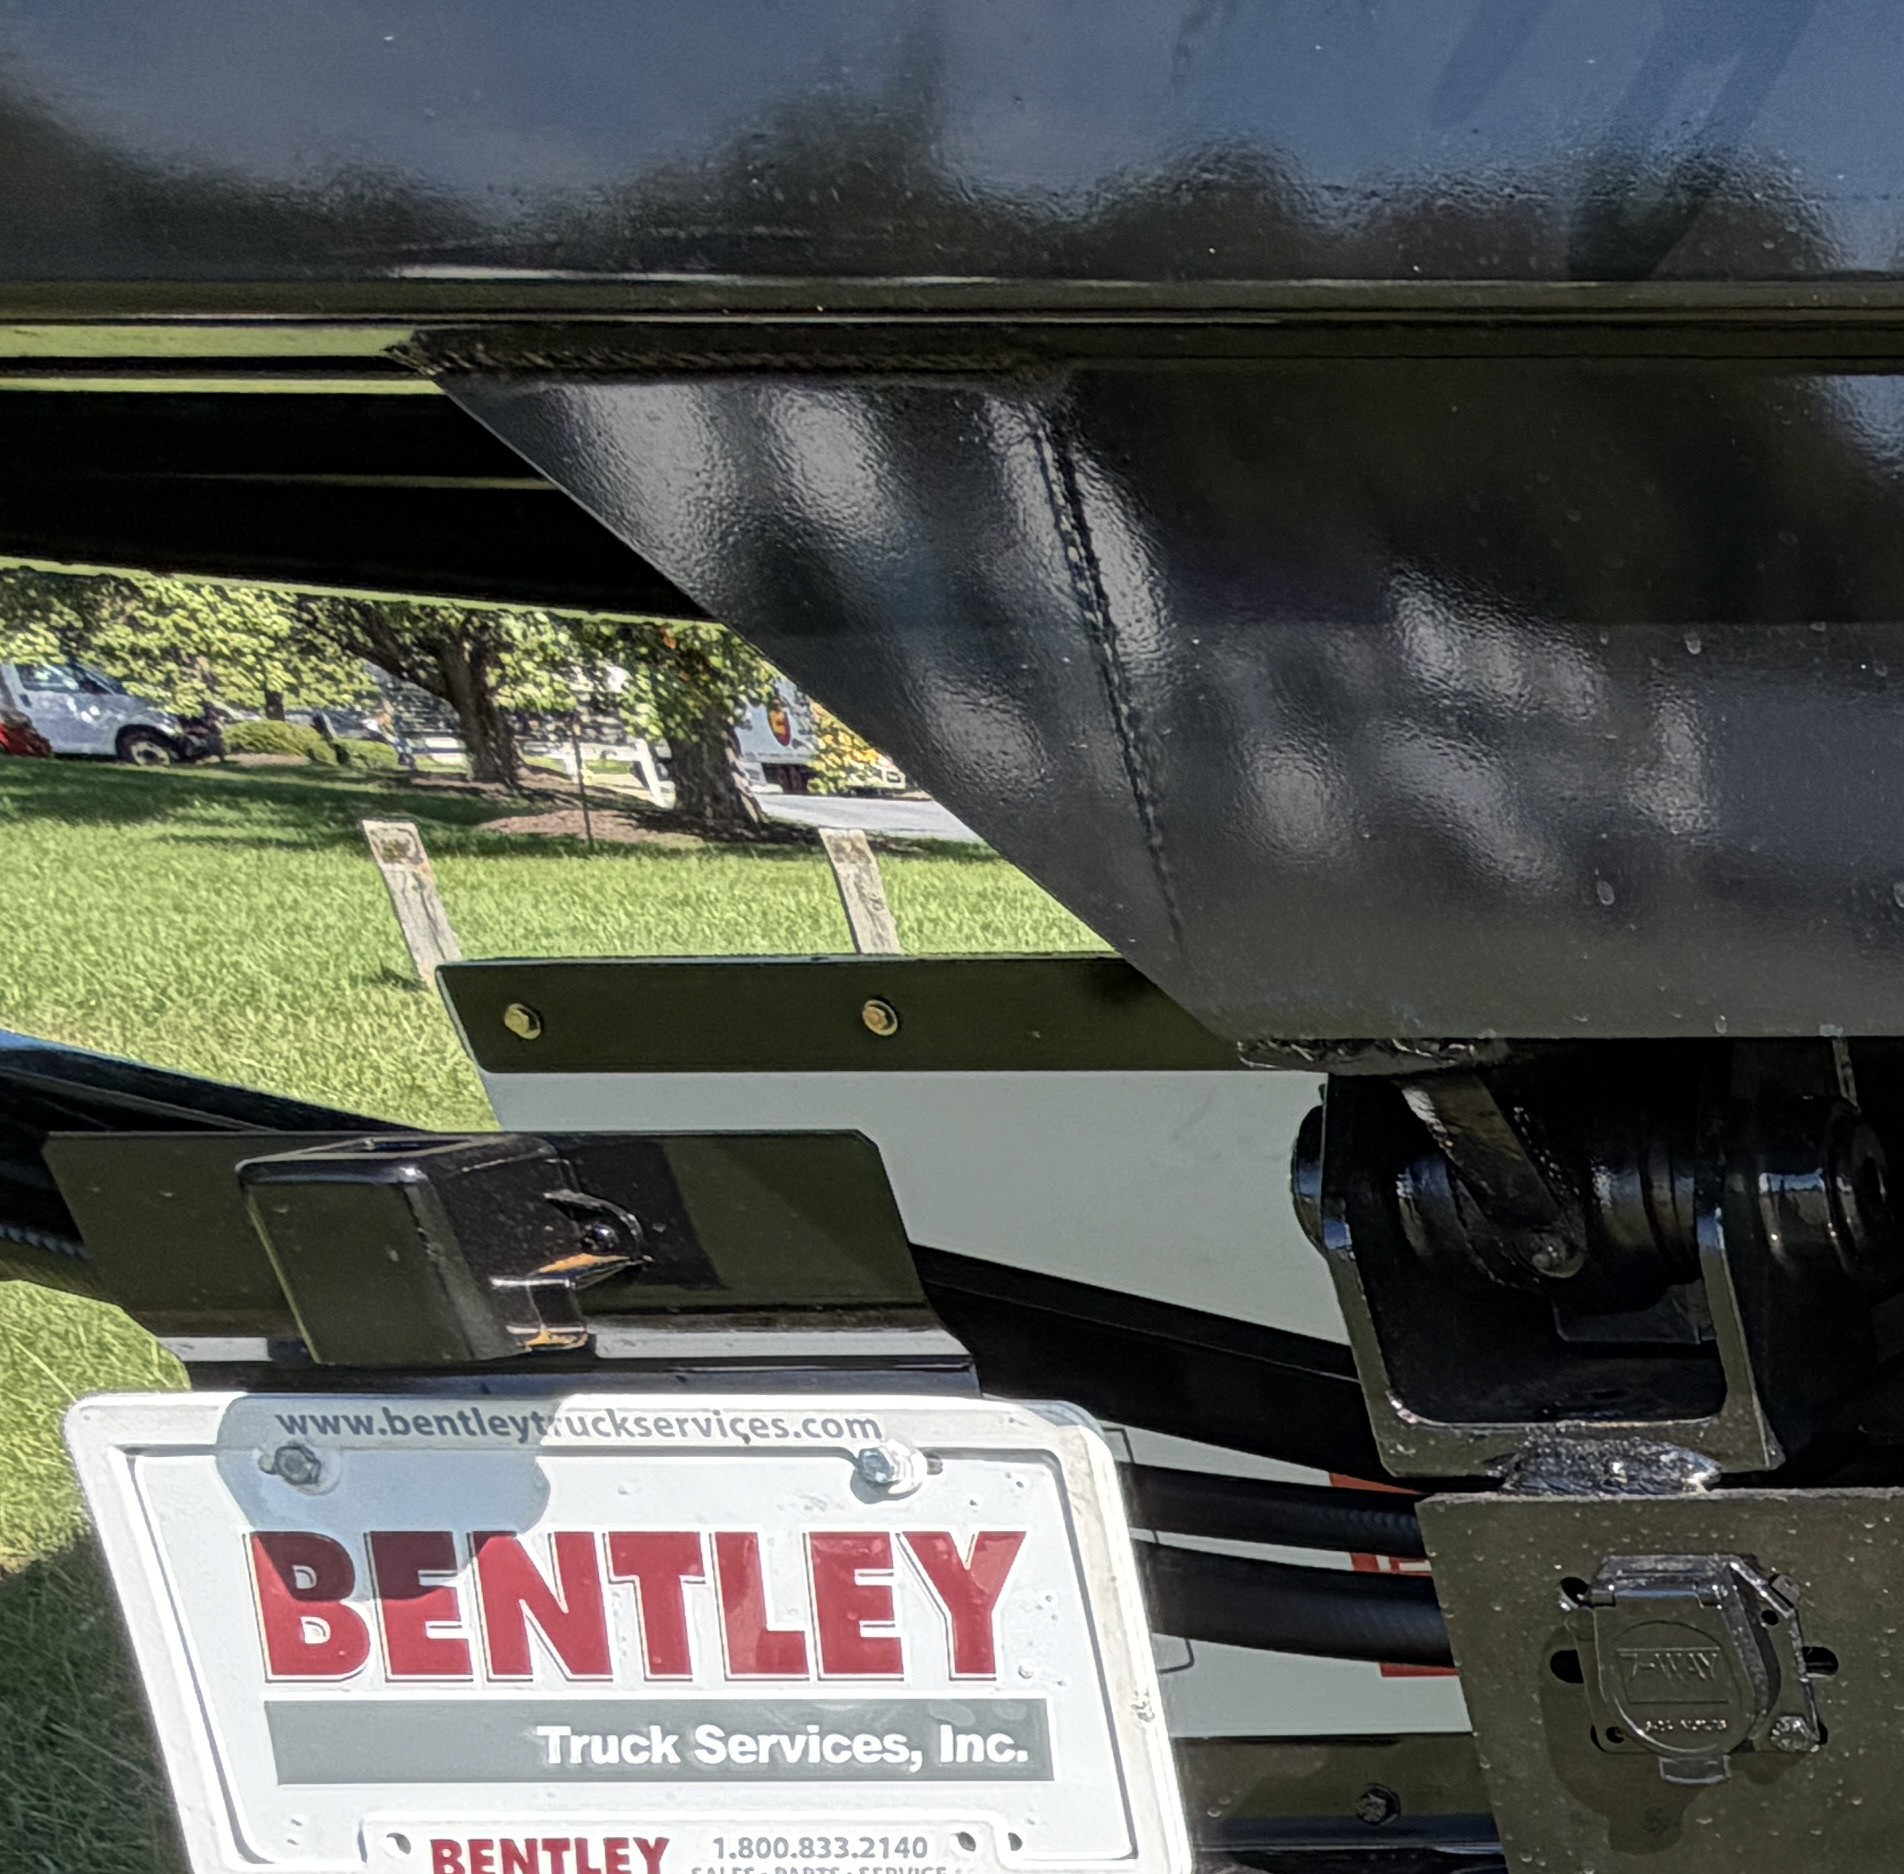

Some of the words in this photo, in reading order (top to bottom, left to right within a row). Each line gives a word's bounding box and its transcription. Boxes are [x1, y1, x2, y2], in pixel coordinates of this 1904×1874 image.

[274, 1405, 884, 1445] www.bentleytruckservices.com
[242, 1530, 1025, 1683] BENTLEY
[536, 1725, 681, 1765] Truck
[694, 1724, 923, 1772] Services,
[939, 1724, 1029, 1763] Inc.
[712, 1836, 930, 1860] 1.800.833.2140
